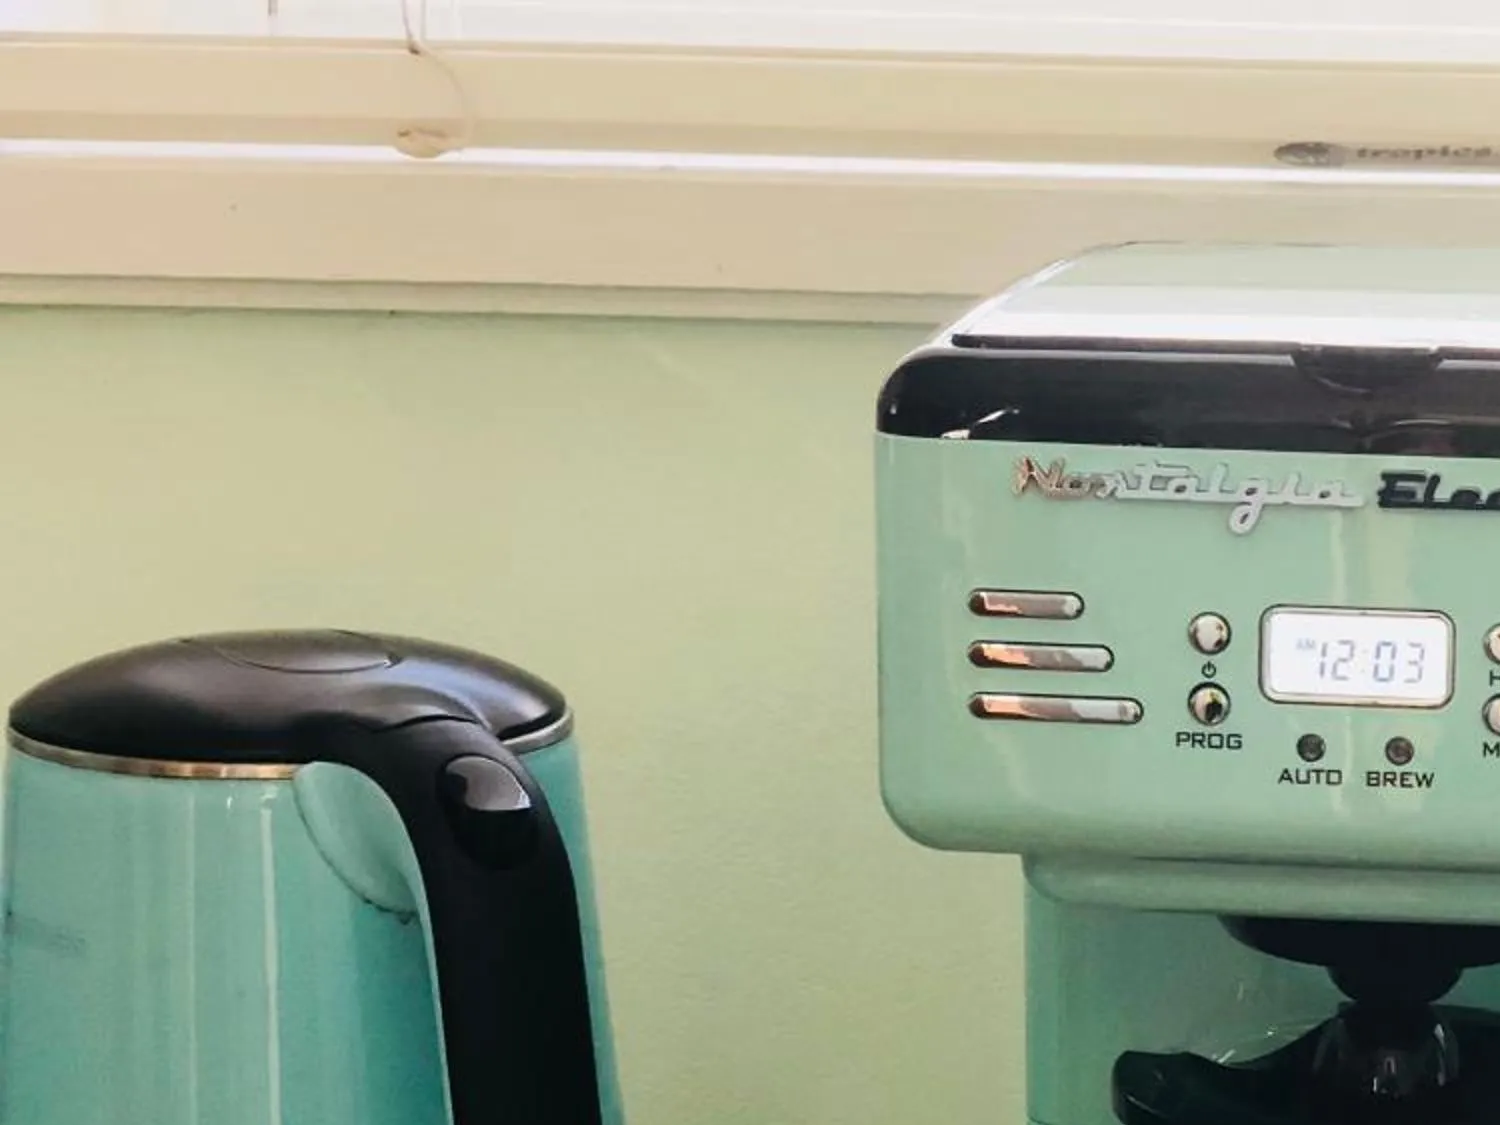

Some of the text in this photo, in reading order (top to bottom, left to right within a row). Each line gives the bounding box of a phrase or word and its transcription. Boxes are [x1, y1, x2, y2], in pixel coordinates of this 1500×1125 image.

[1012, 457, 1367, 535] Nostalgia
[1176, 732, 1243, 749] PROG
[1278, 769, 1342, 786] AUTO
[1366, 771, 1435, 788] BREW
